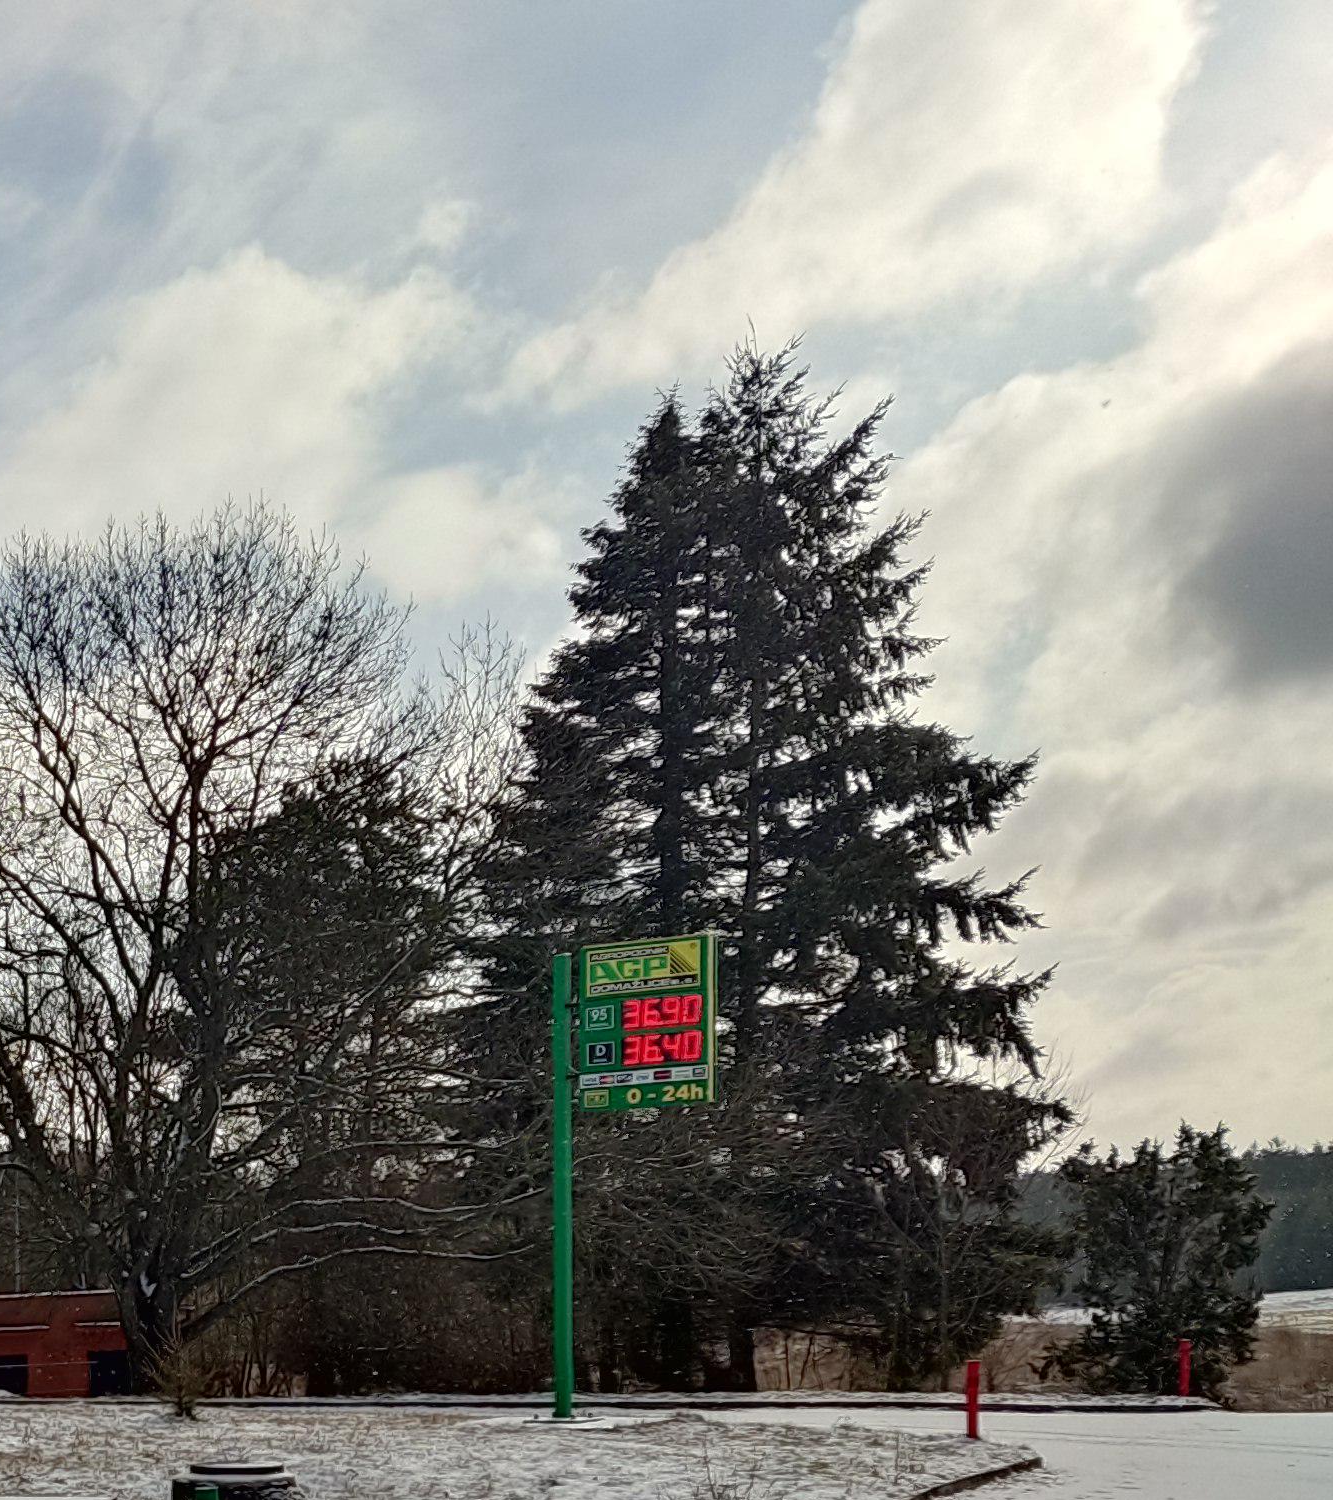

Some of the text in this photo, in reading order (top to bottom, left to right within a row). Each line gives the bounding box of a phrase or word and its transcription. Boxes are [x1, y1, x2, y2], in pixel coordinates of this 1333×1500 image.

[596, 1045, 606, 1057] D
[626, 1088, 642, 1104] 0
[661, 1083, 704, 1102] 24h
